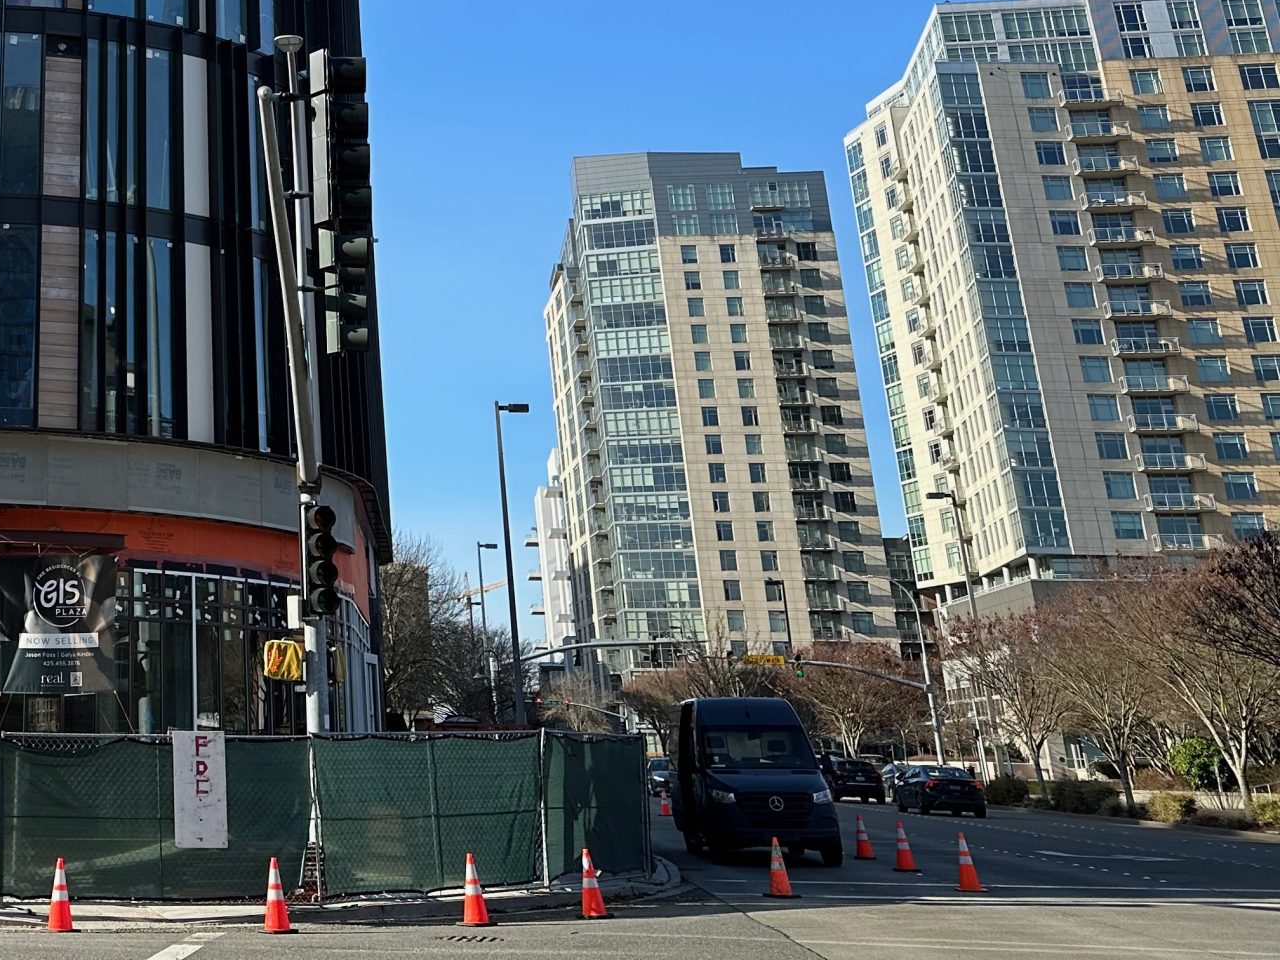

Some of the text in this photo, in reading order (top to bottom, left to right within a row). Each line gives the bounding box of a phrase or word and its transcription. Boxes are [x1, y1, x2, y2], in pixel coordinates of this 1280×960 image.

[37, 578, 80, 608] GIS
[55, 608, 88, 616] PLAZA
[26, 636, 94, 645] NOW SELLING
